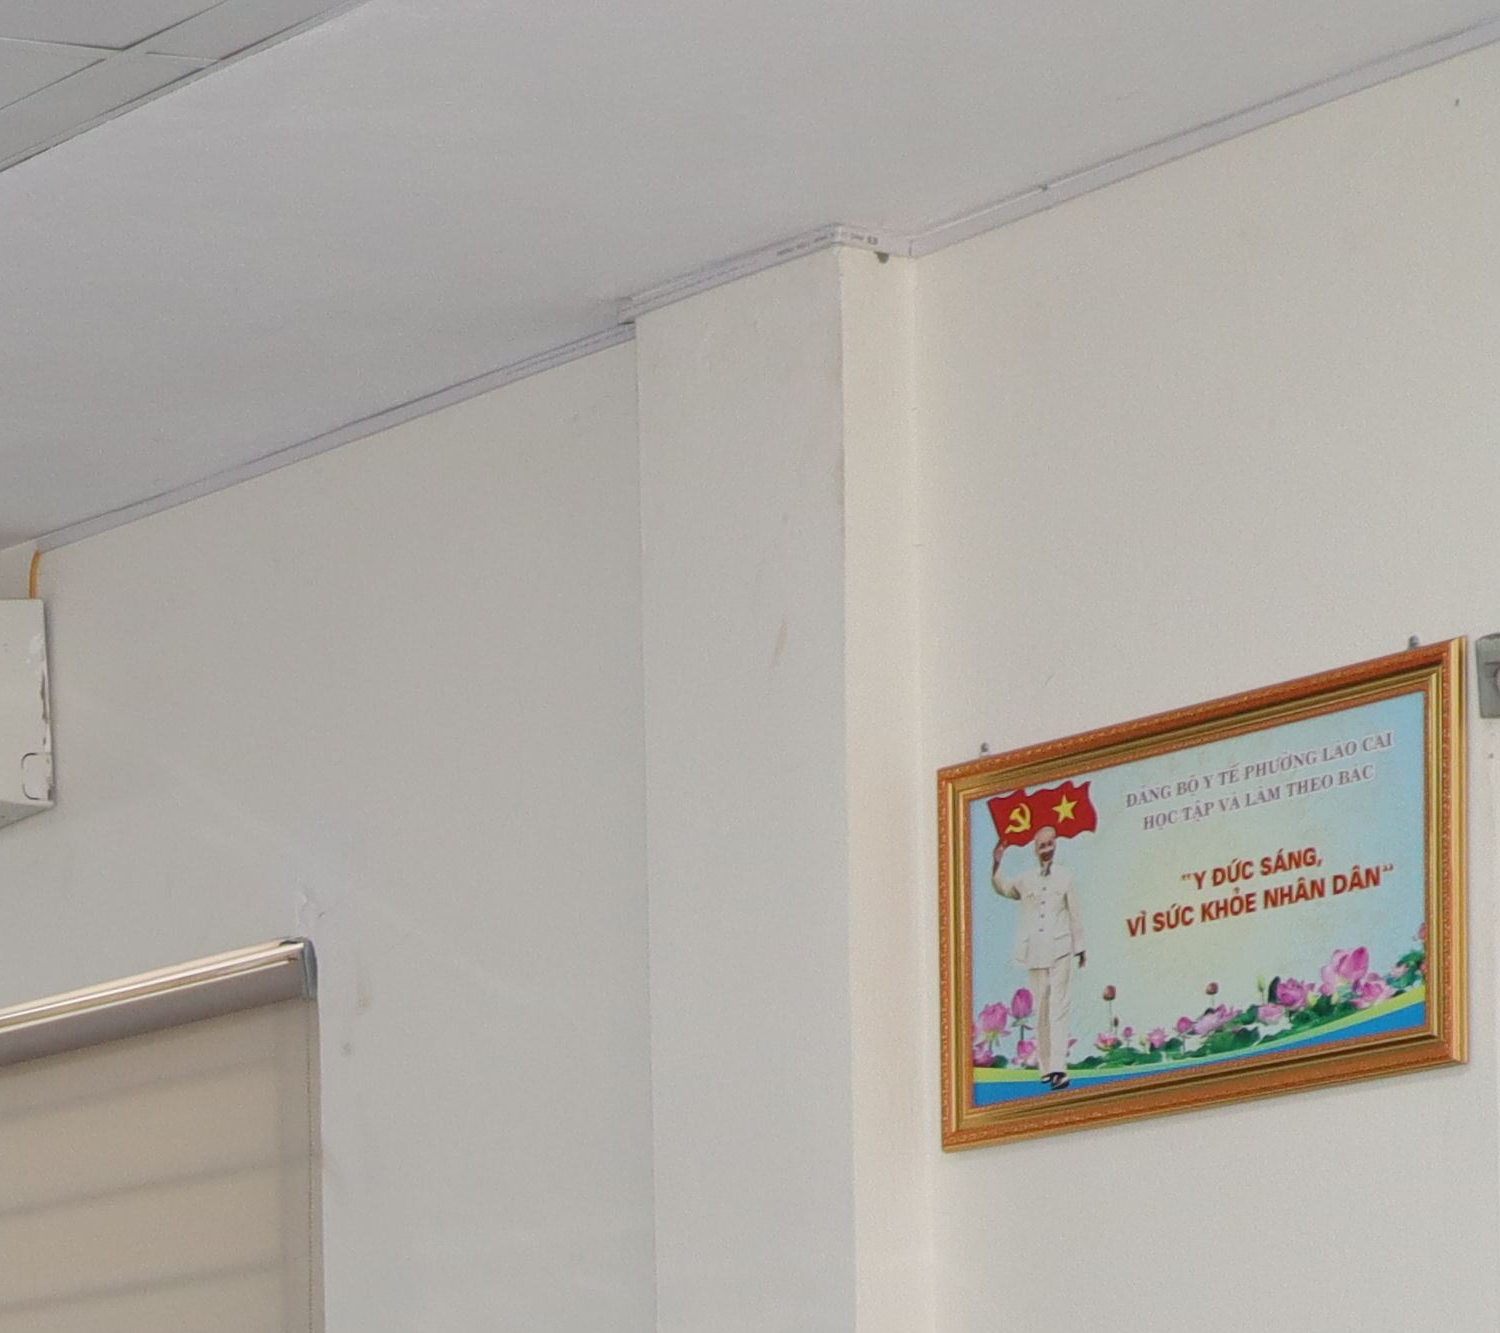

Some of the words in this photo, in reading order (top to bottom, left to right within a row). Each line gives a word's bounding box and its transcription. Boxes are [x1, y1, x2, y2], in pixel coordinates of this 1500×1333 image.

[1126, 784, 1172, 808] ĐẢNG
[1176, 774, 1199, 796] BỘ
[1203, 774, 1214, 789] Y
[1218, 762, 1241, 786] TẾ
[1244, 750, 1318, 780] PHƯỜNG
[1322, 739, 1358, 762] LÀO
[1362, 732, 1393, 752] CAI
[1143, 810, 1178, 831] HỌC
[1182, 799, 1215, 822] TẬP
[1218, 792, 1240, 812] VÀ
[1245, 785, 1281, 807] LÀM
[1286, 774, 1334, 797] THEO
[1338, 762, 1374, 785] BÁC
[1212, 858, 1254, 886] ĐỨC
[1260, 847, 1323, 876] SÁNG,
[1126, 909, 1147, 937] VÌ
[1152, 903, 1195, 933] SỨC
[1201, 886, 1257, 923] KHỎE
[1263, 876, 1326, 909] NHÂN
